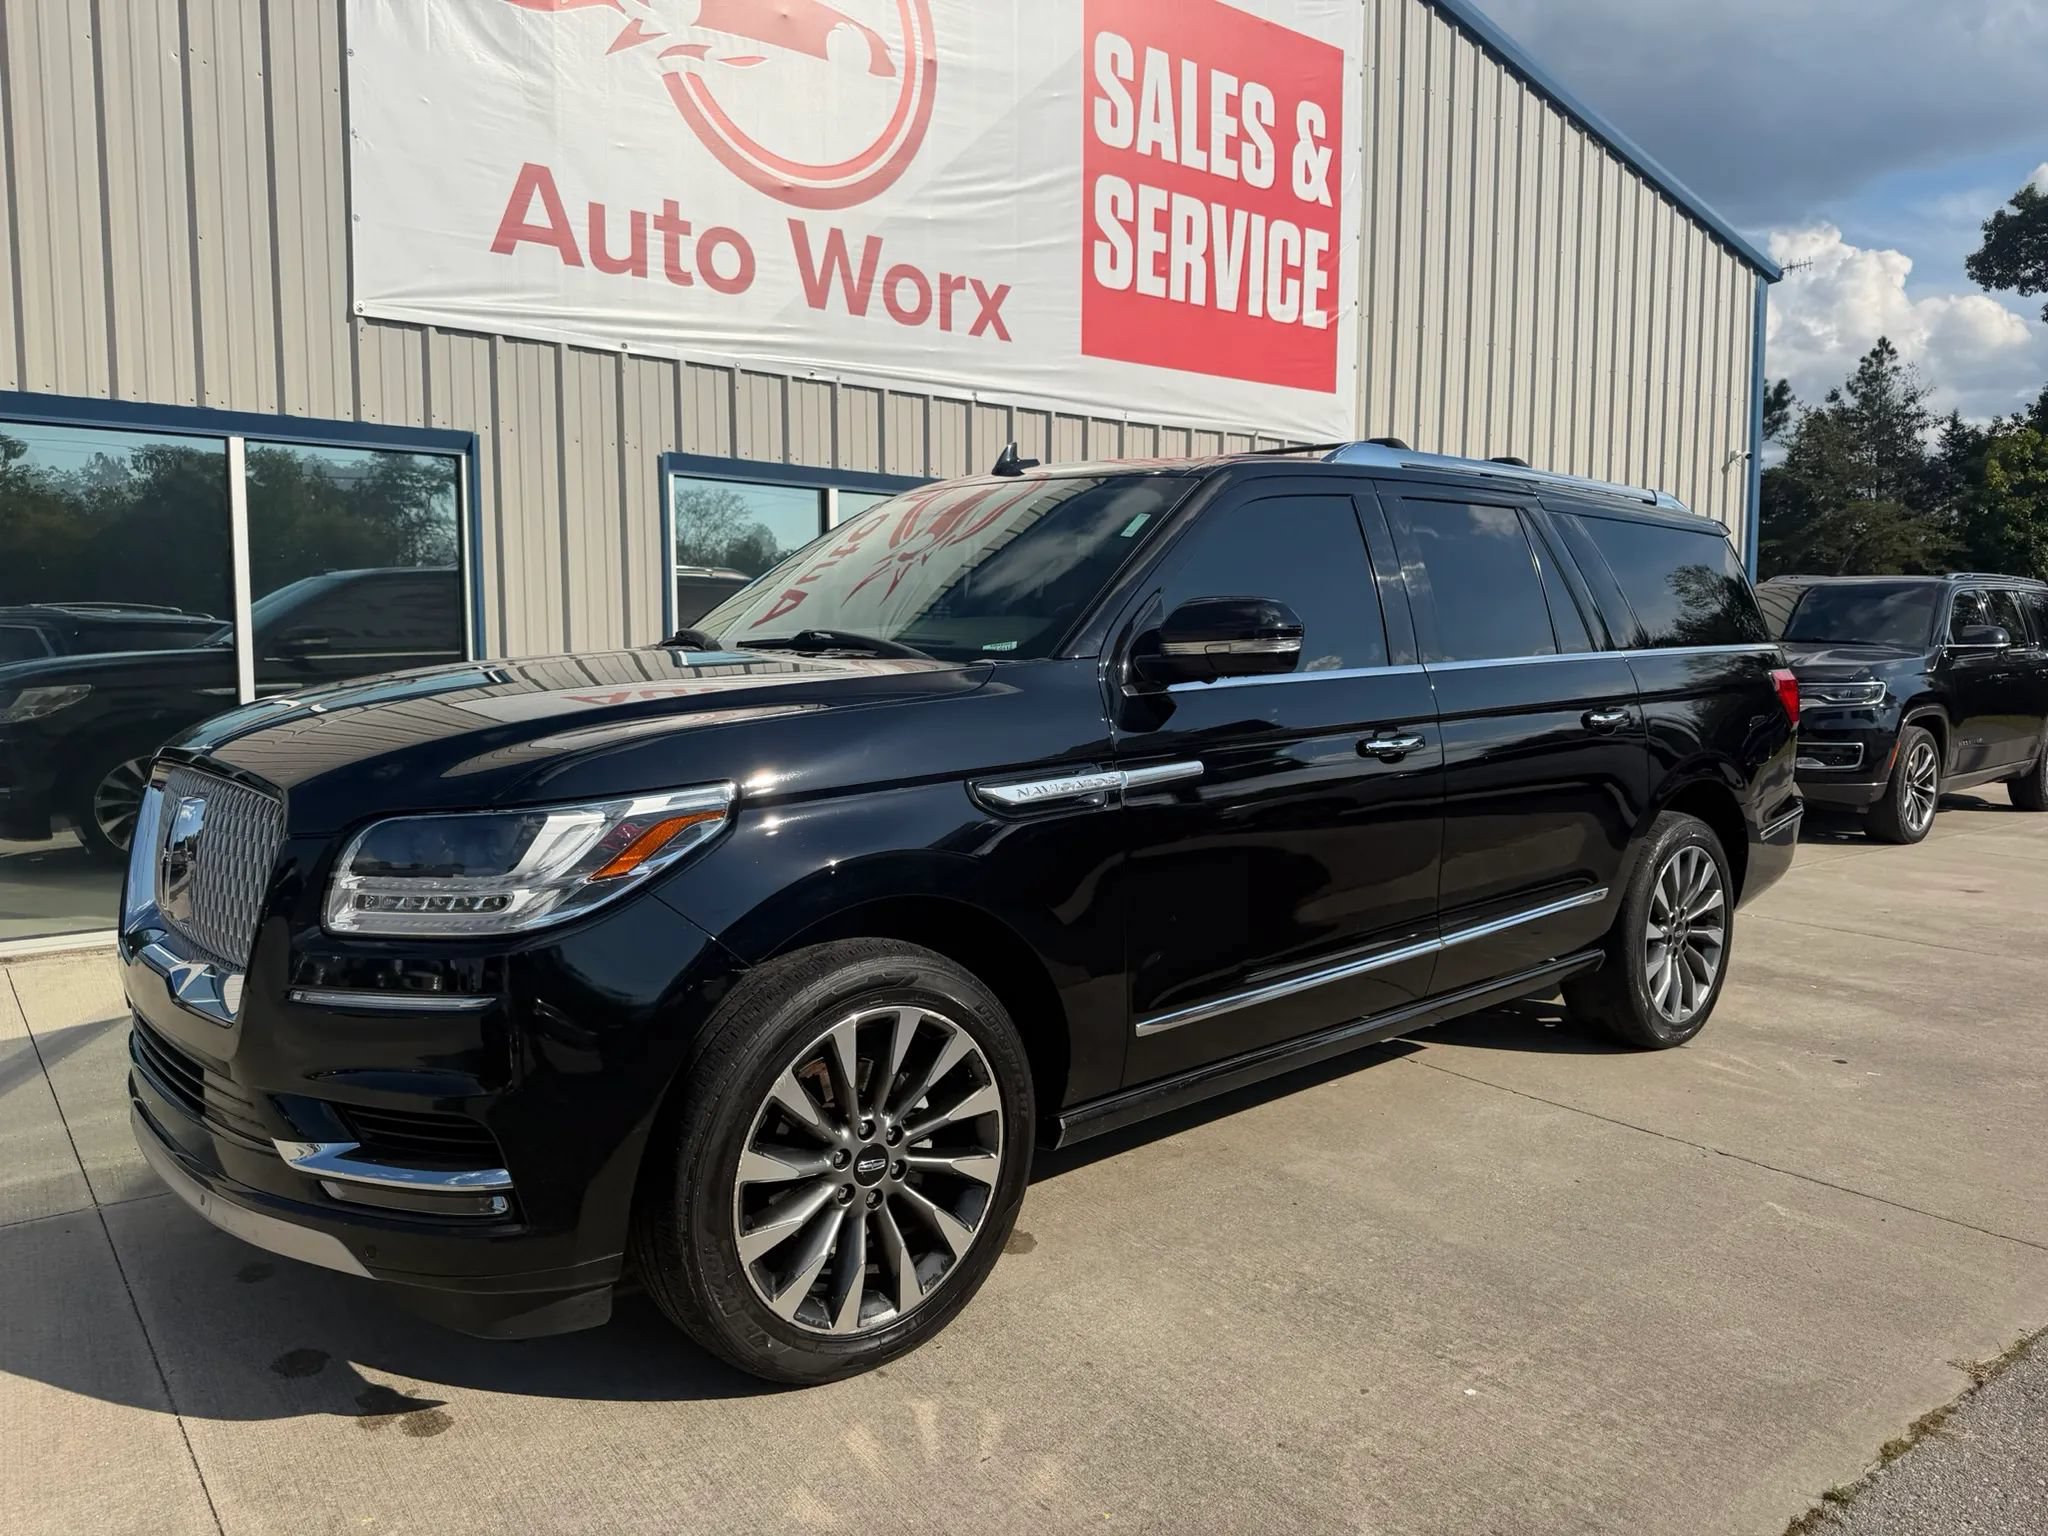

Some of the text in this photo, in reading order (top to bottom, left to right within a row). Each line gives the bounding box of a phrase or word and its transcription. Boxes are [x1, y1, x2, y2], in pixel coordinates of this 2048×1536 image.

[1094, 31, 1333, 207] SALES &
[490, 162, 1011, 342] Auto Worx
[1094, 174, 1329, 329] SERVICE
